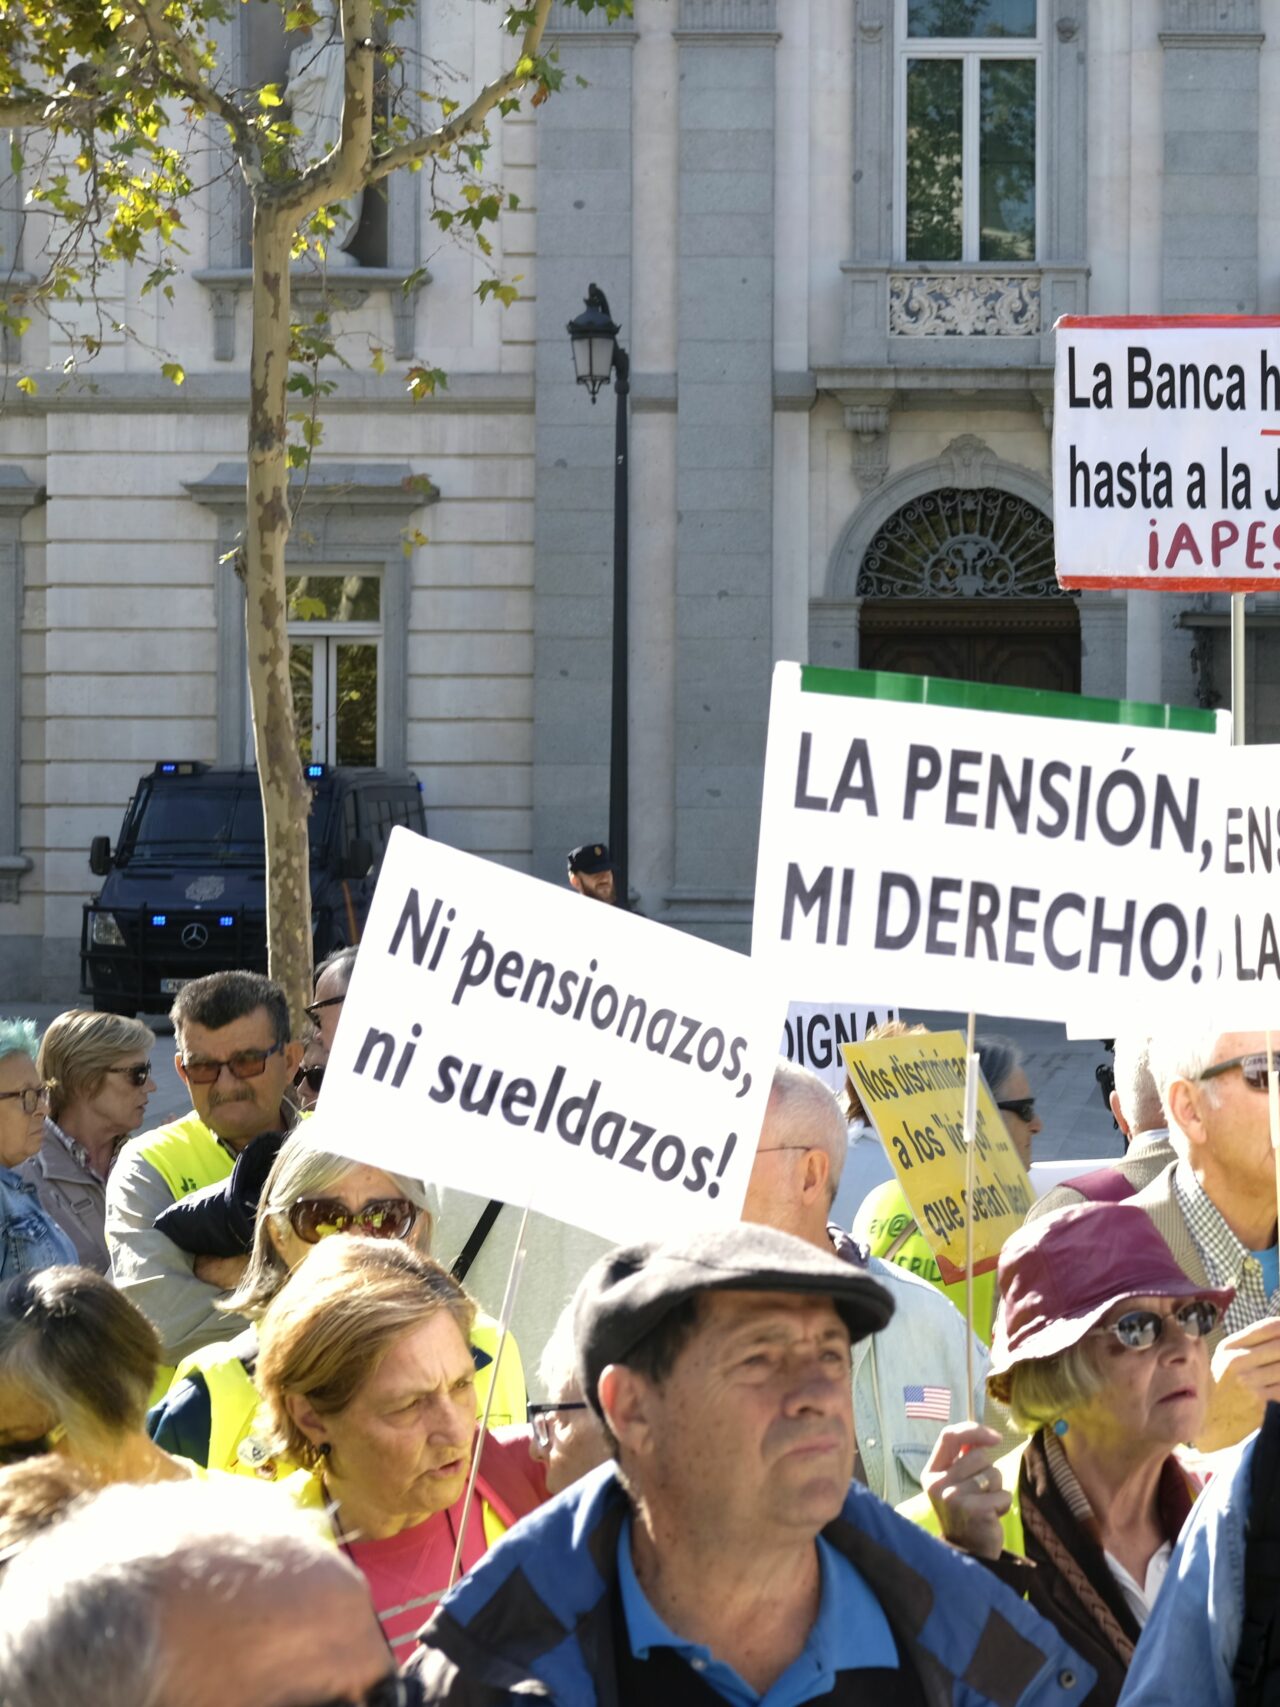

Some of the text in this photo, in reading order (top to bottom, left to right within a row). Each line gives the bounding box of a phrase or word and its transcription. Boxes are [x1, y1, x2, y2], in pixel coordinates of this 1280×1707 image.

[1068, 346, 1113, 409] La
[1127, 347, 1246, 410] Banca
[1069, 445, 1173, 509] hasta
[1187, 462, 1206, 509] a
[1221, 446, 1251, 510] la
[794, 731, 1213, 873] LA PENSIÓN,
[780, 862, 1207, 984] MI DERECHO!
[387, 888, 753, 1098] Ni pensionazos,
[353, 1023, 738, 1199] ni sueldazos!
[853, 1060, 899, 1102] Nos
[892, 1135, 912, 1170] a
[902, 1120, 946, 1163] los
[923, 1196, 965, 1246] que
